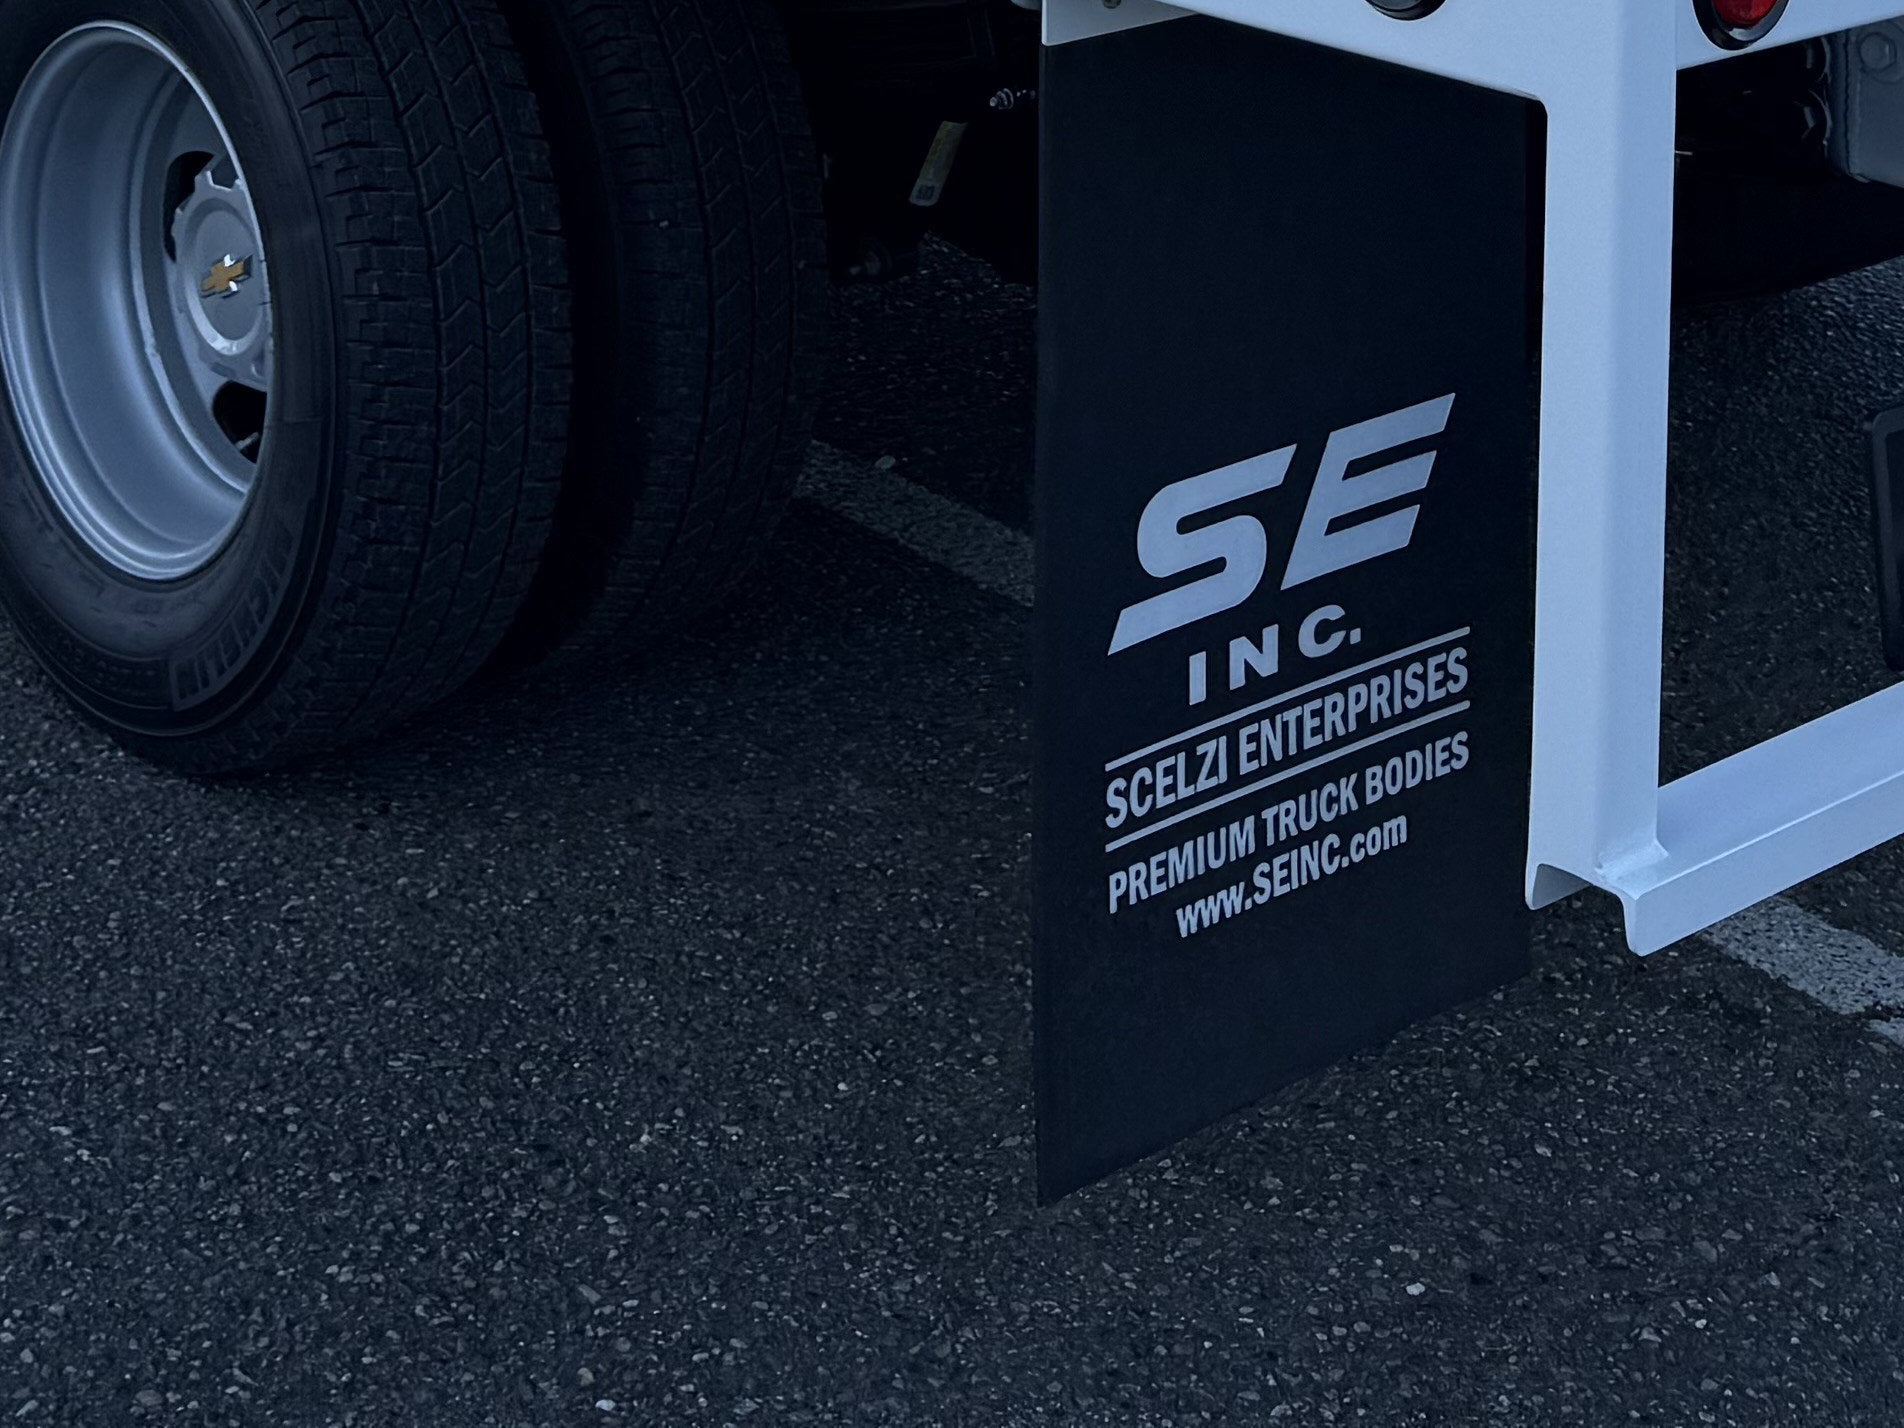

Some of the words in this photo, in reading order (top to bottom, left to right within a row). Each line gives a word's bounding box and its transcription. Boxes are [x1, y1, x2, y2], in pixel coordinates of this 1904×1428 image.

[1108, 392, 1455, 655] SE
[1106, 735, 1227, 828] SCELZI
[1238, 647, 1468, 772] ENTERPRISES
[1188, 604, 1361, 705] INC.
[1109, 814, 1254, 913] PREMIUM
[1262, 772, 1358, 848] TRUCK
[1366, 731, 1468, 805] BODIES
[1176, 812, 1407, 938] www.SEINC.com
